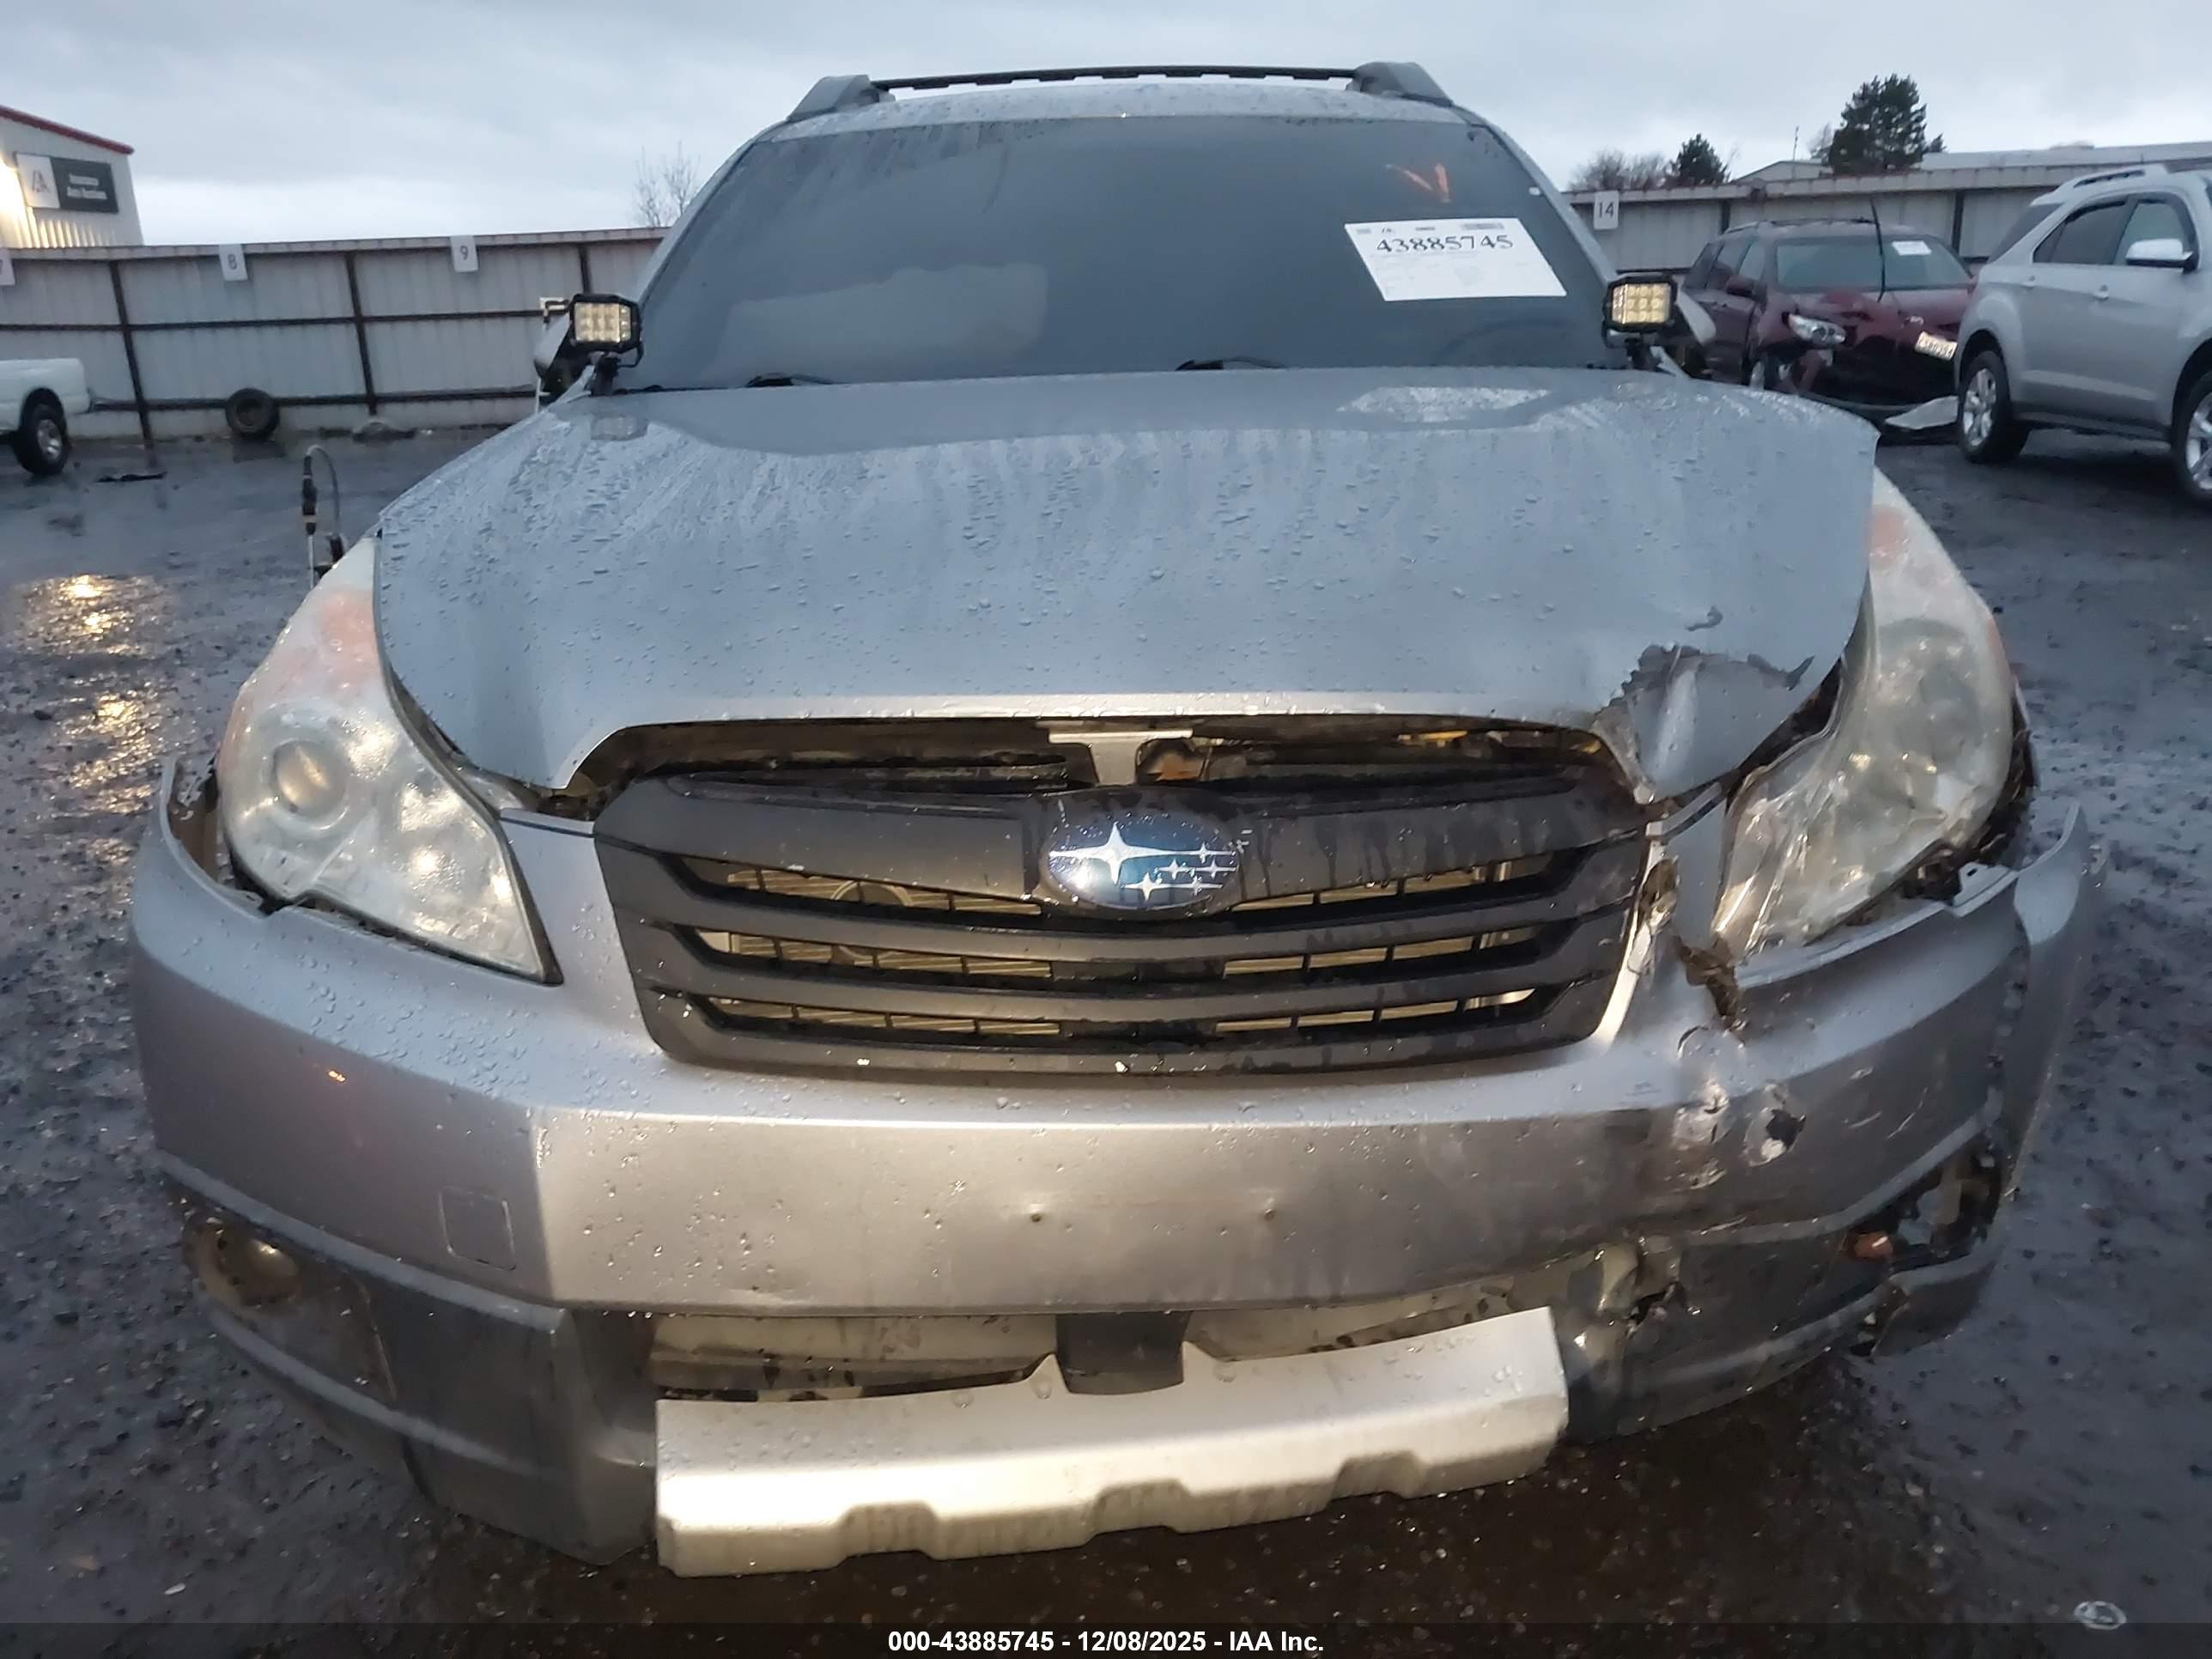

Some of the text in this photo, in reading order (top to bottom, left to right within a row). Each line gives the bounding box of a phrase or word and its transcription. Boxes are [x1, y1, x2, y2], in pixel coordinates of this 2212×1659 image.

[1598, 201, 1614, 218] 14
[1376, 234, 1514, 253] 43885745
[227, 253, 238, 270] 8
[459, 245, 469, 261] 9
